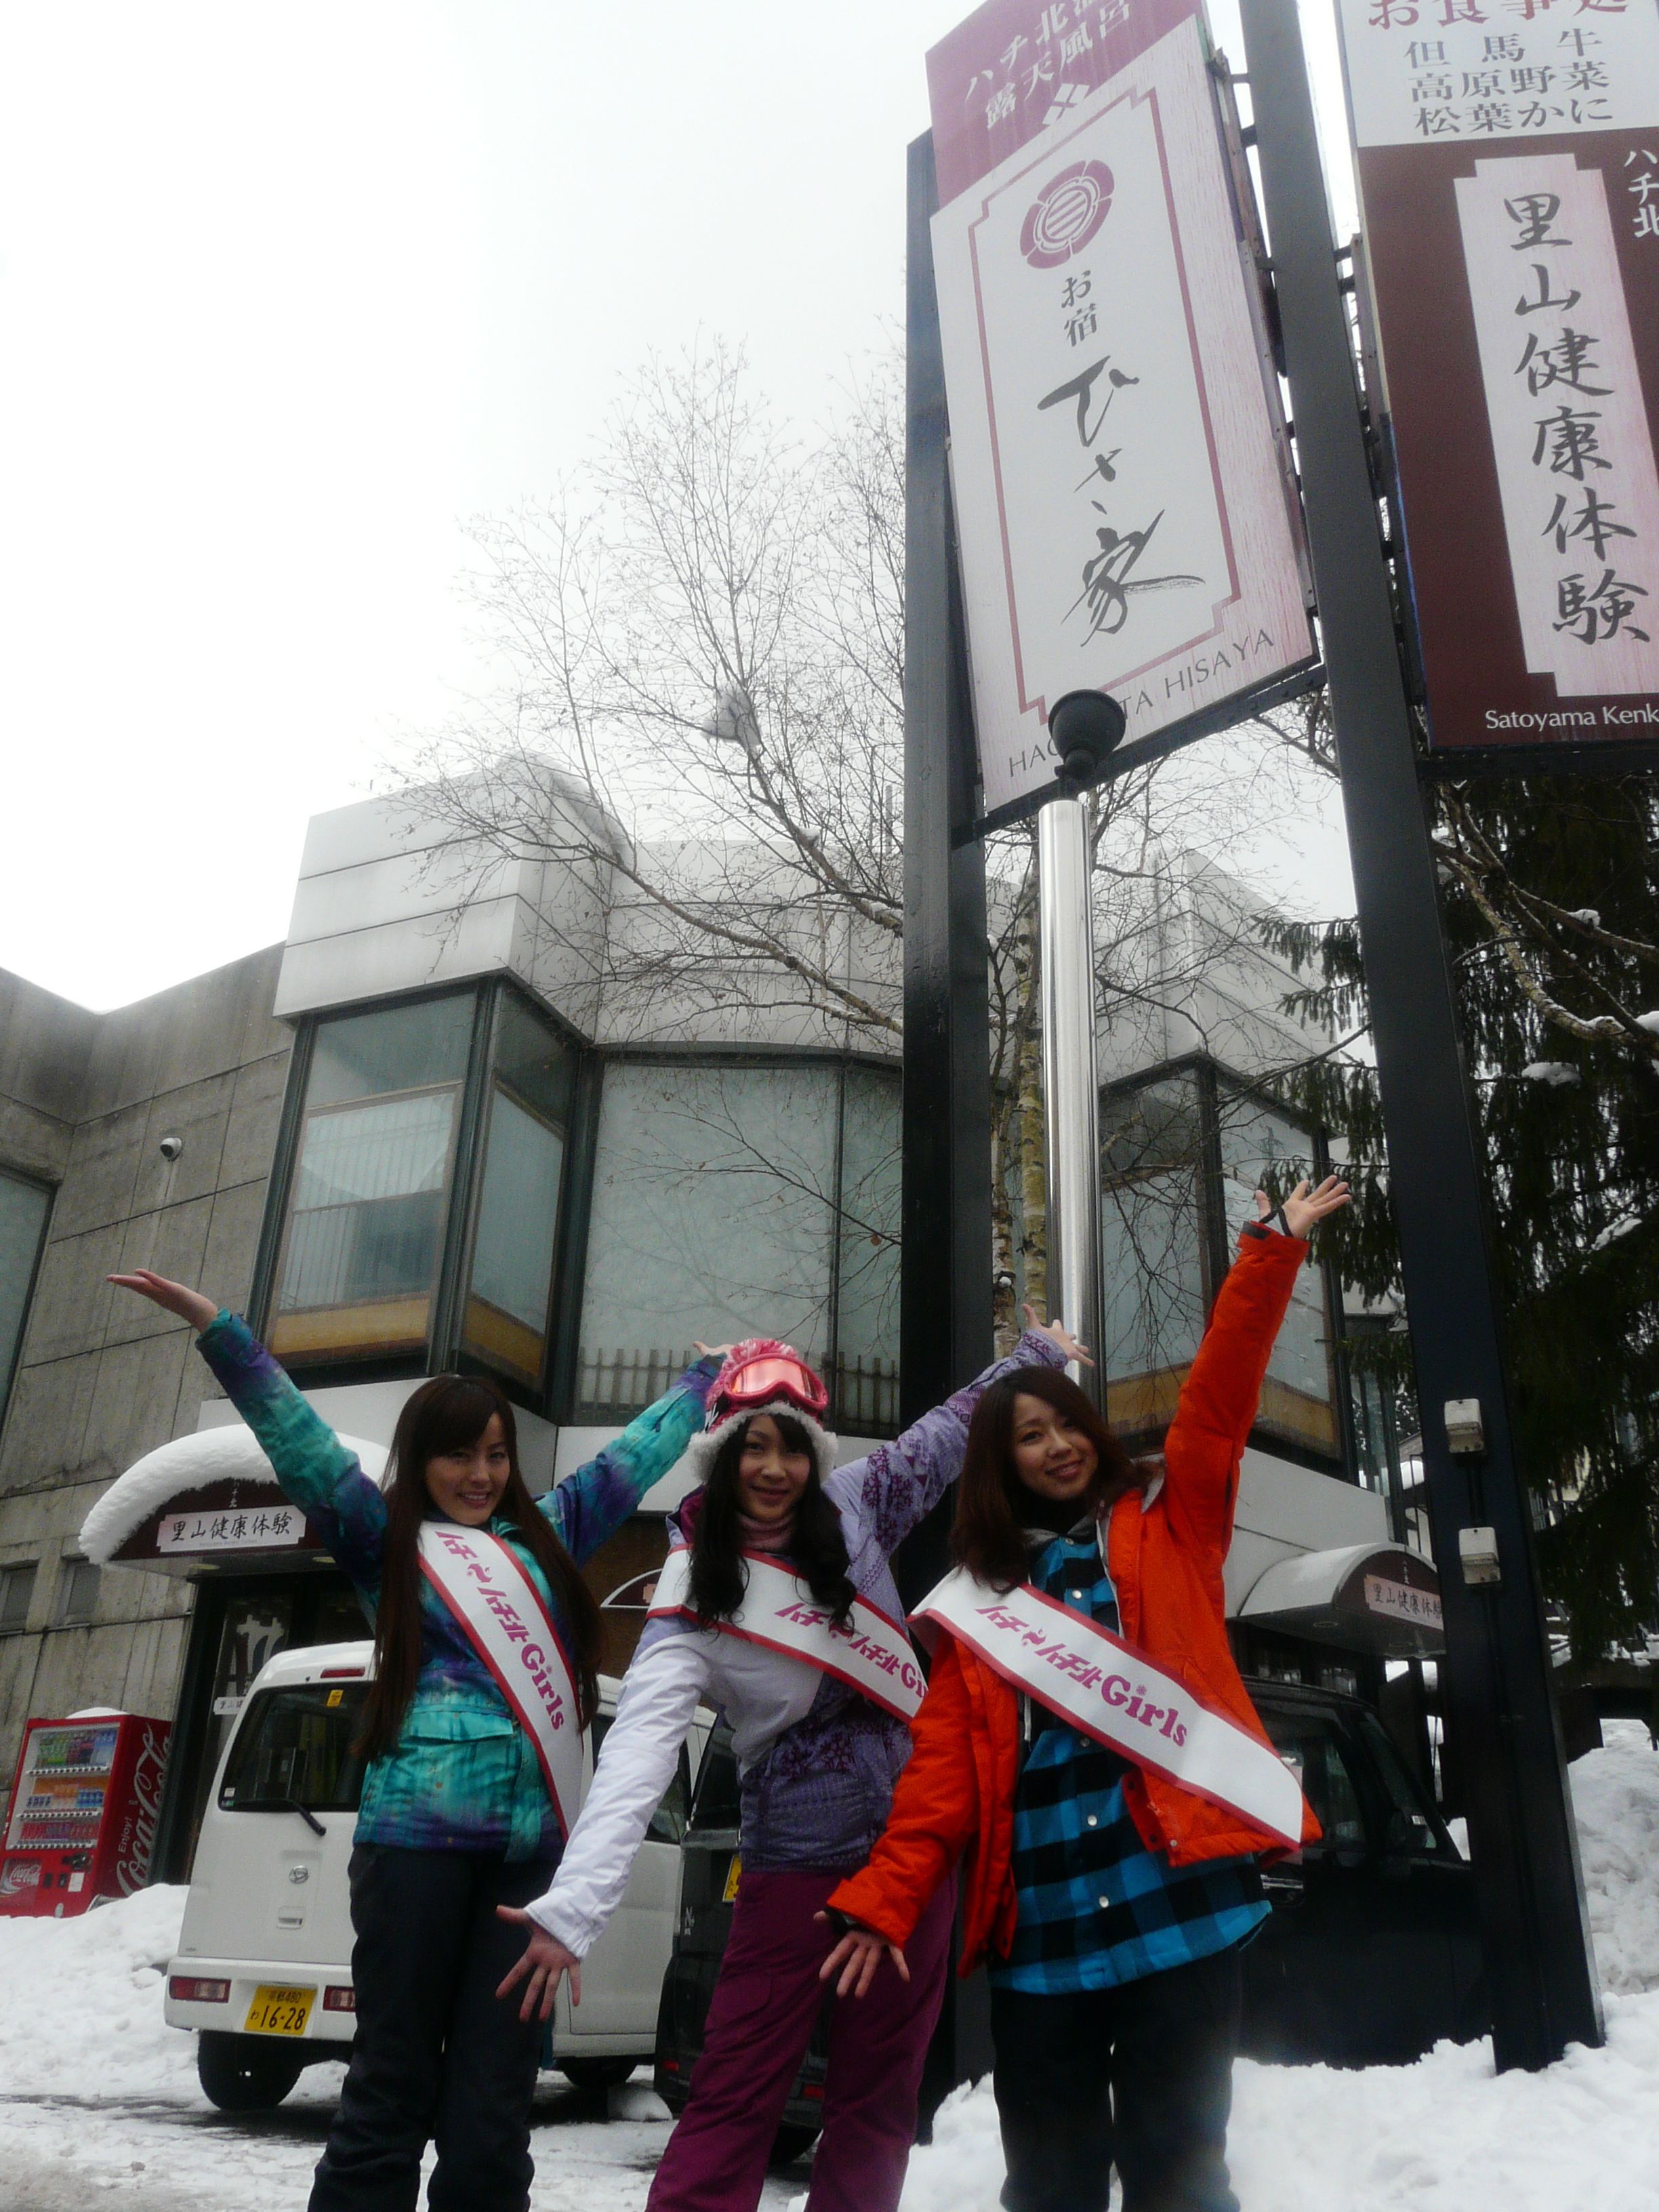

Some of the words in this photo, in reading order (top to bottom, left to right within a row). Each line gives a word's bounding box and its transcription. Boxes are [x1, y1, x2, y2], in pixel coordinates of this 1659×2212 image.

[965, 0, 1095, 102] ハチ北
[985, 0, 1130, 130] 露天風呂
[1404, 28, 1603, 69] 但馬牛
[1408, 61, 1610, 102] 高原野菜
[1415, 98, 1613, 136] 松葉かに
[1061, 270, 1099, 348] お宿
[1503, 192, 1650, 644] 里山健康体験
[1164, 629, 1275, 699] HISAYA
[1484, 710, 1597, 732] Satoyama
[170, 1511, 293, 1542] 里山健康体験
[520, 1643, 565, 1732] Girls
[1101, 1674, 1188, 1747] Girls
